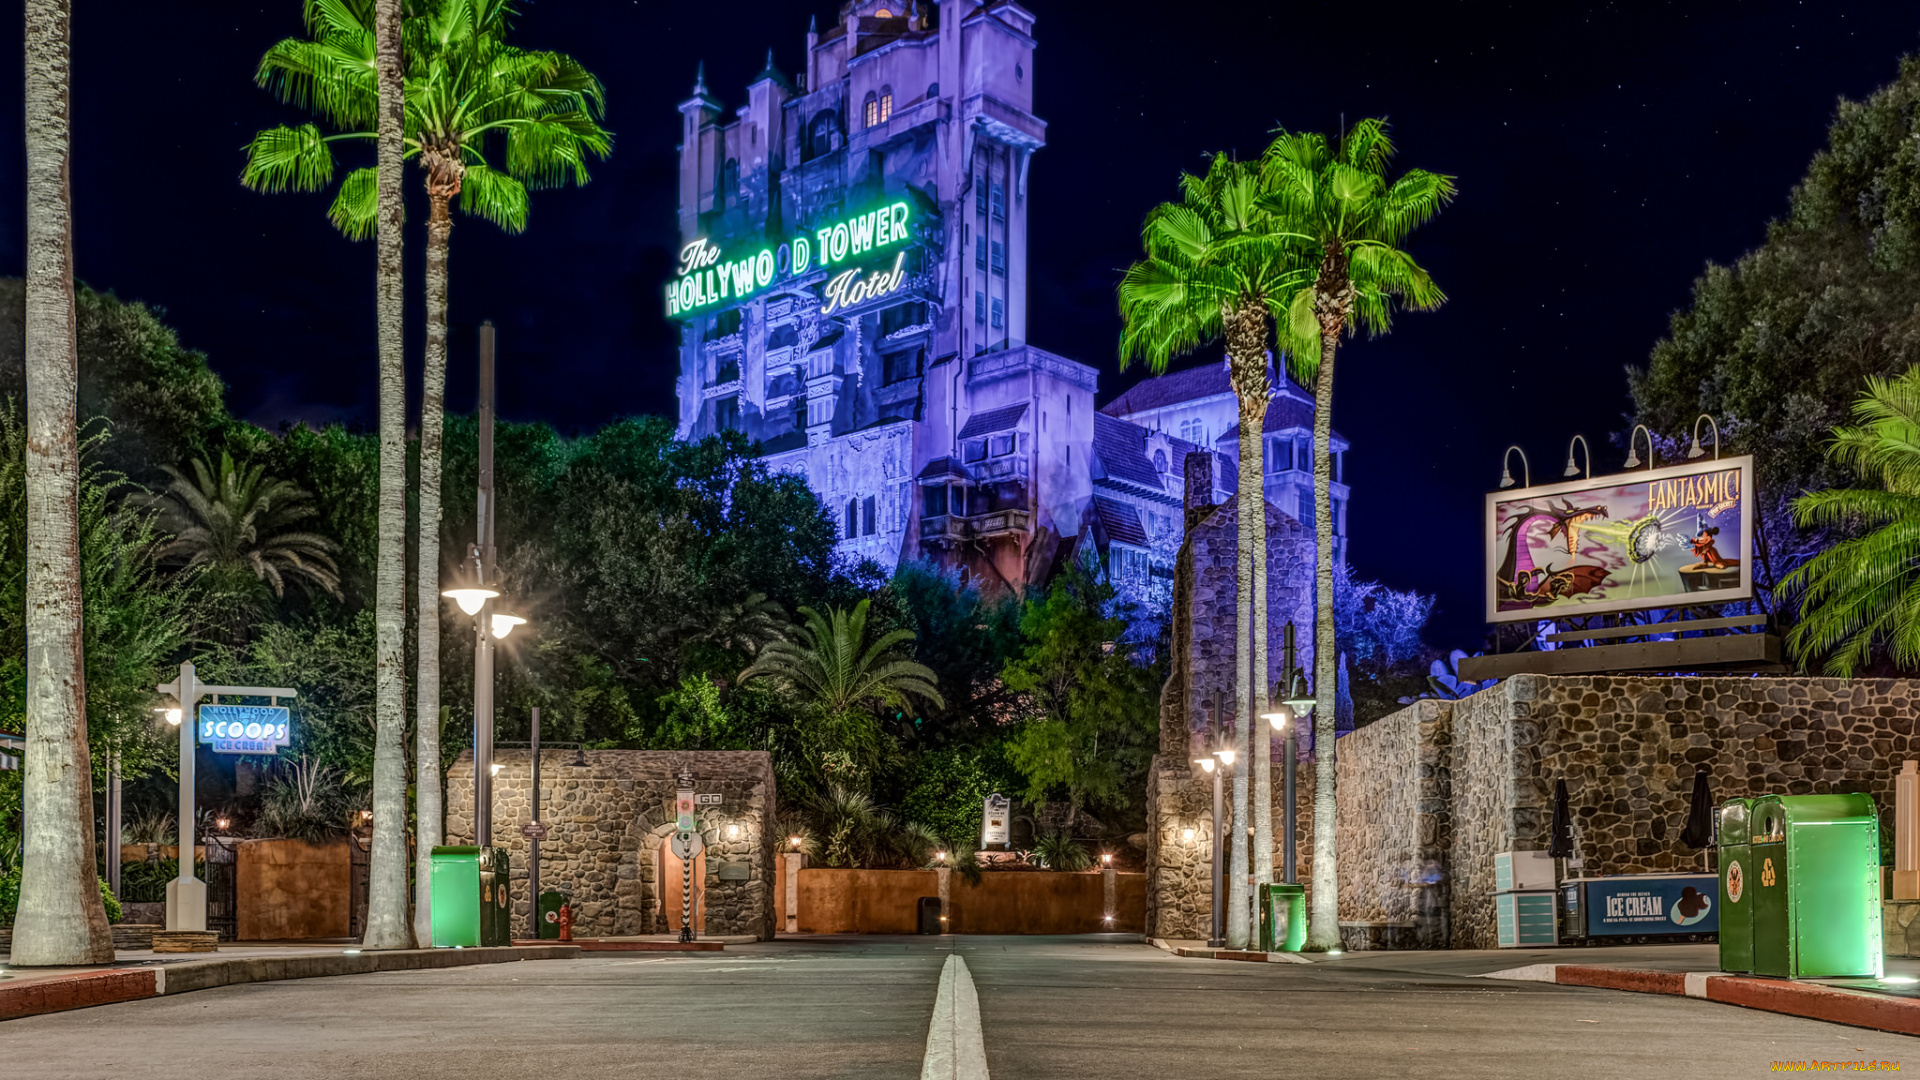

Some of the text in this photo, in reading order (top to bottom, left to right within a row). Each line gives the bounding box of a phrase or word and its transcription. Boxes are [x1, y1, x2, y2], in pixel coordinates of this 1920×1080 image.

[665, 201, 909, 317] HOLLYWOOD TOWER
[677, 238, 721, 276] The
[820, 251, 906, 315] Hotel
[1648, 470, 1740, 511] FANTASMIC!
[212, 706, 275, 716] HOLLYWOOD
[203, 721, 286, 740] SCOOPS
[215, 740, 273, 751] ICE CREAM
[1606, 895, 1662, 917] ICE CREAM
